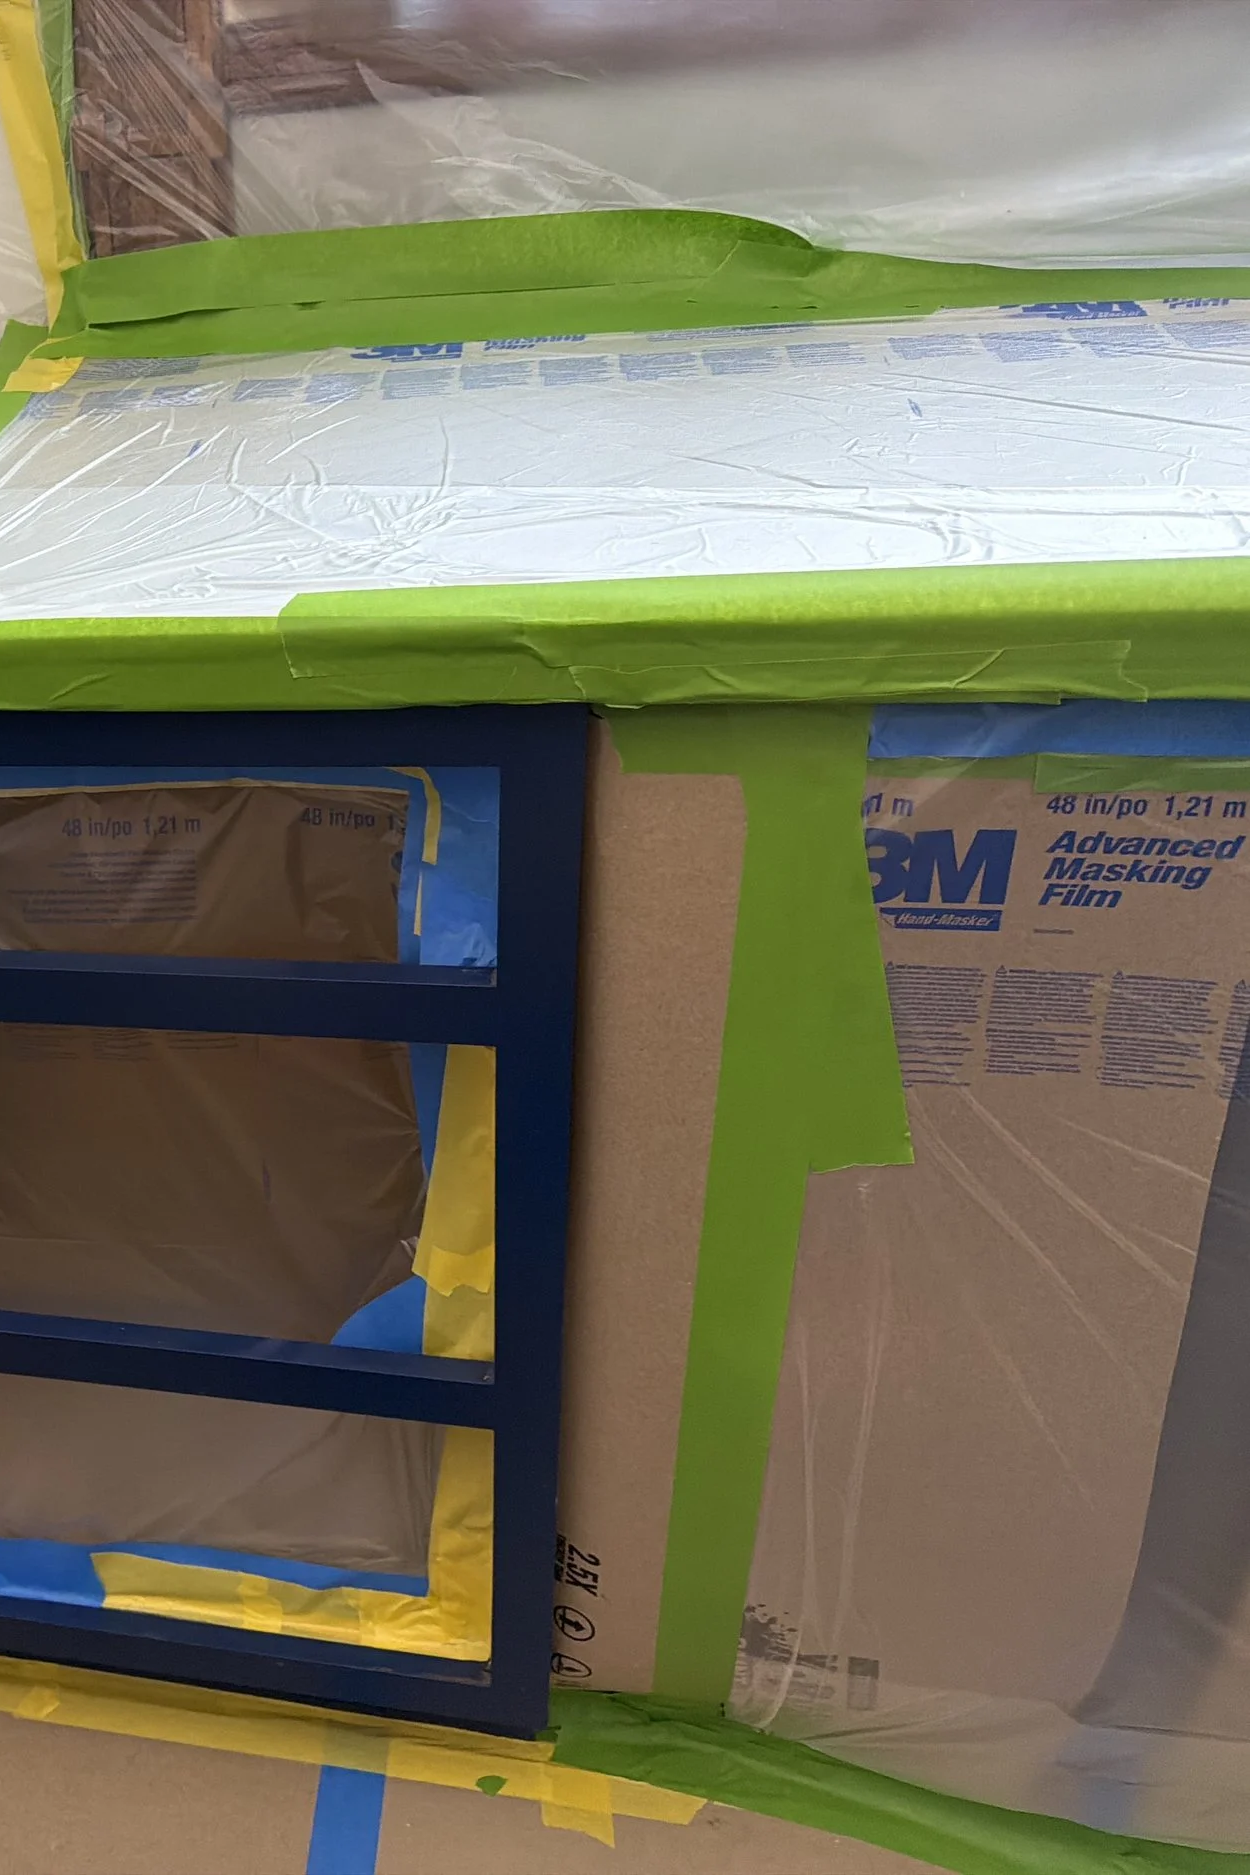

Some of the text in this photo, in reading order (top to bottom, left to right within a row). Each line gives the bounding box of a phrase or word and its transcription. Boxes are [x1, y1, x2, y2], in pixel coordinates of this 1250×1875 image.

[329, 808, 376, 830] in/po
[1046, 794, 1247, 821] 48 in/po 1,21 m
[62, 815, 201, 840] 48 in/po 1,21 m
[1045, 830, 1247, 860] Advanced
[865, 827, 1018, 905] 3M
[1043, 856, 1213, 890] Masking
[1038, 883, 1123, 909] Film
[897, 913, 994, 927] Hand-Masker
